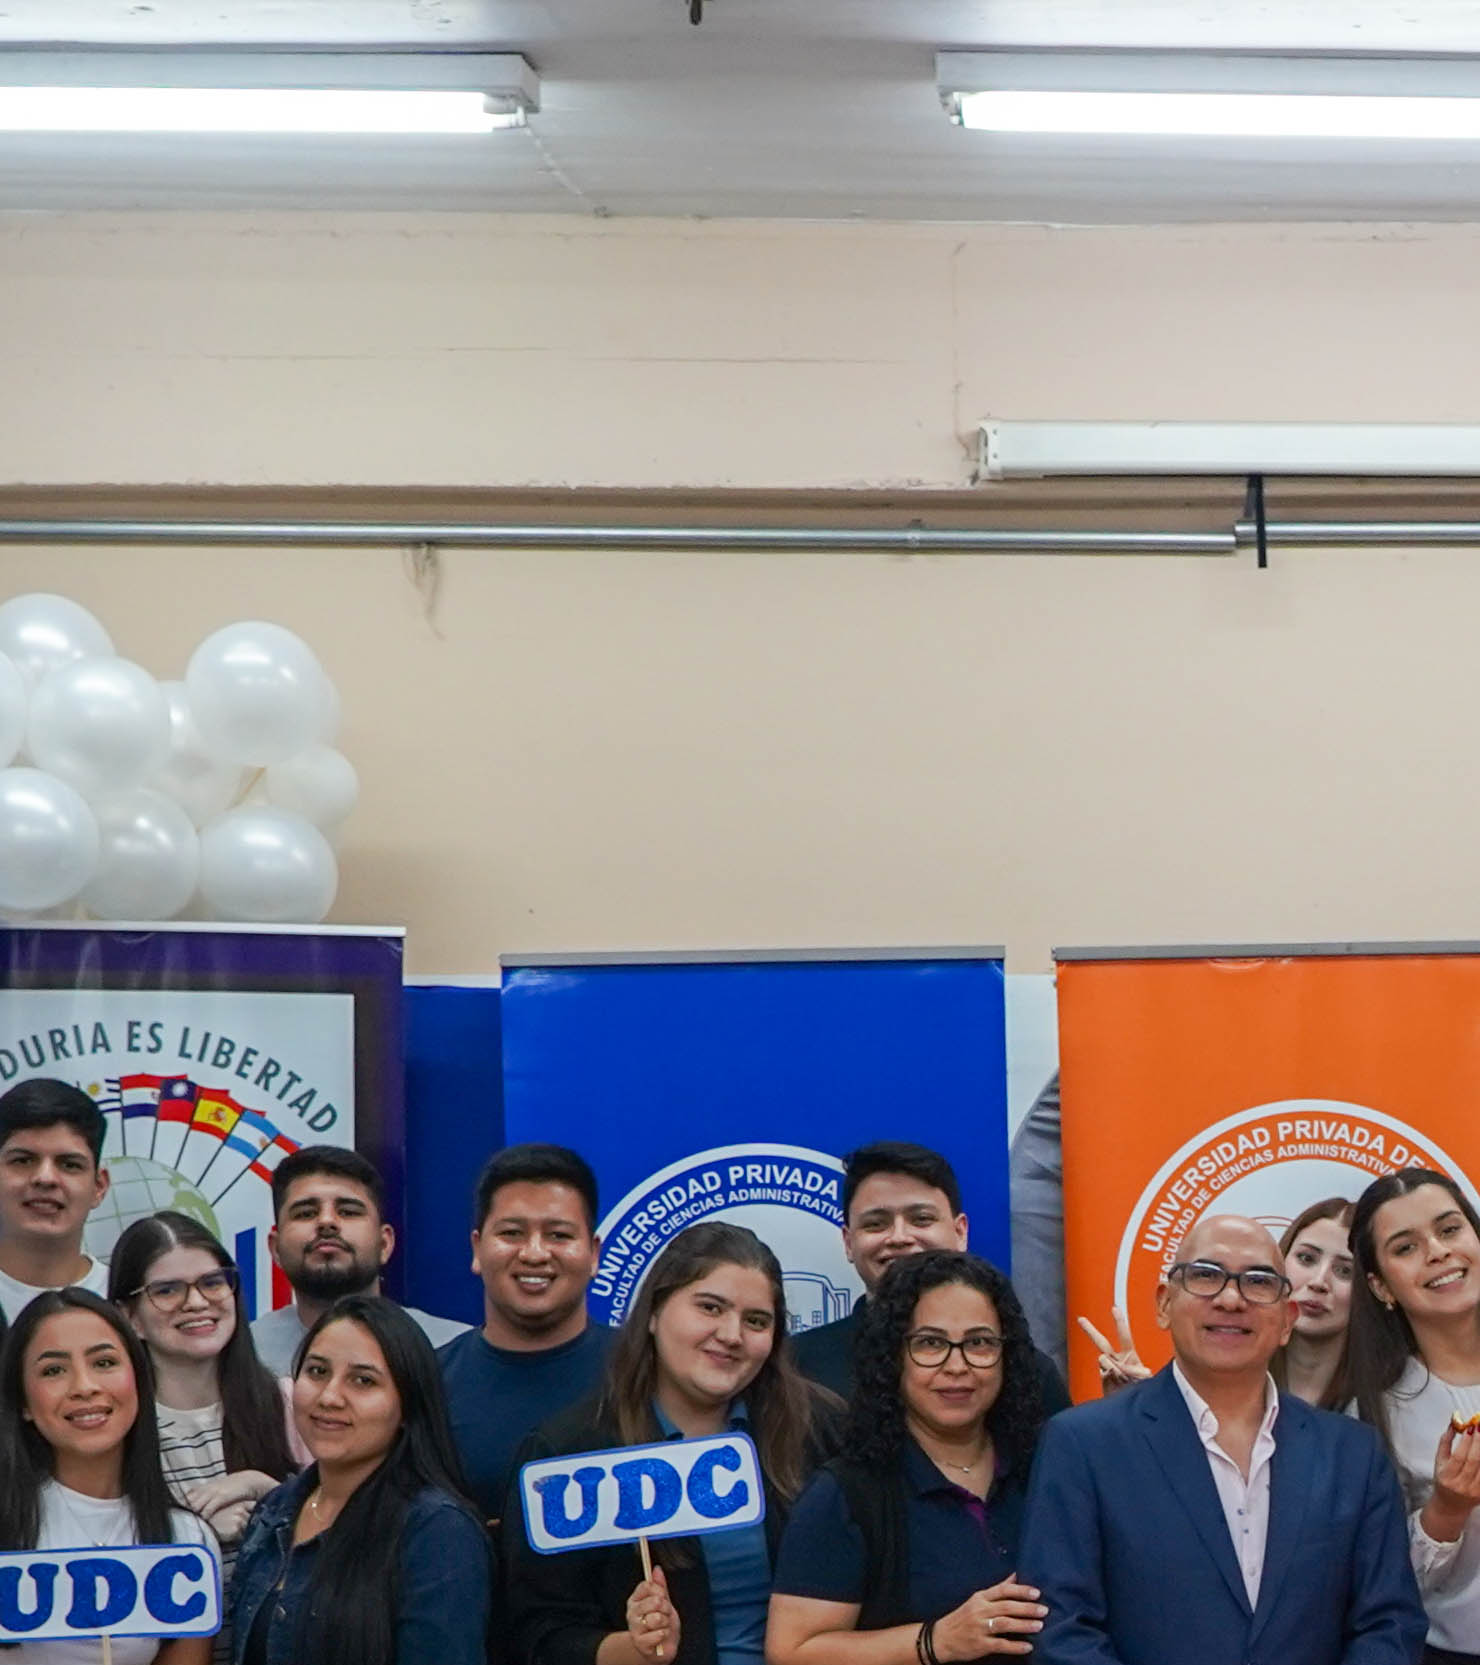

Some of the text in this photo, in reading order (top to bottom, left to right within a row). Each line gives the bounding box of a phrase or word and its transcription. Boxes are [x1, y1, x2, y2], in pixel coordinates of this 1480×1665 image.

[127, 1020, 165, 1053] ES
[178, 1026, 339, 1134] LIBERTAD
[591, 1164, 838, 1297] UNIVERSIDAD PRIVADA
[1142, 1127, 1272, 1254] UNIVERSIDAD
[1277, 1120, 1385, 1156] PRIVADA
[1158, 1207, 1197, 1285] FACULTAD
[1192, 1189, 1212, 1209] DE
[1209, 1149, 1275, 1192] CIENCIAS
[608, 1188, 845, 1327] FACULTAD DE CIENCIAS ADMINISTRATIV
[532, 1445, 749, 1540] UDC
